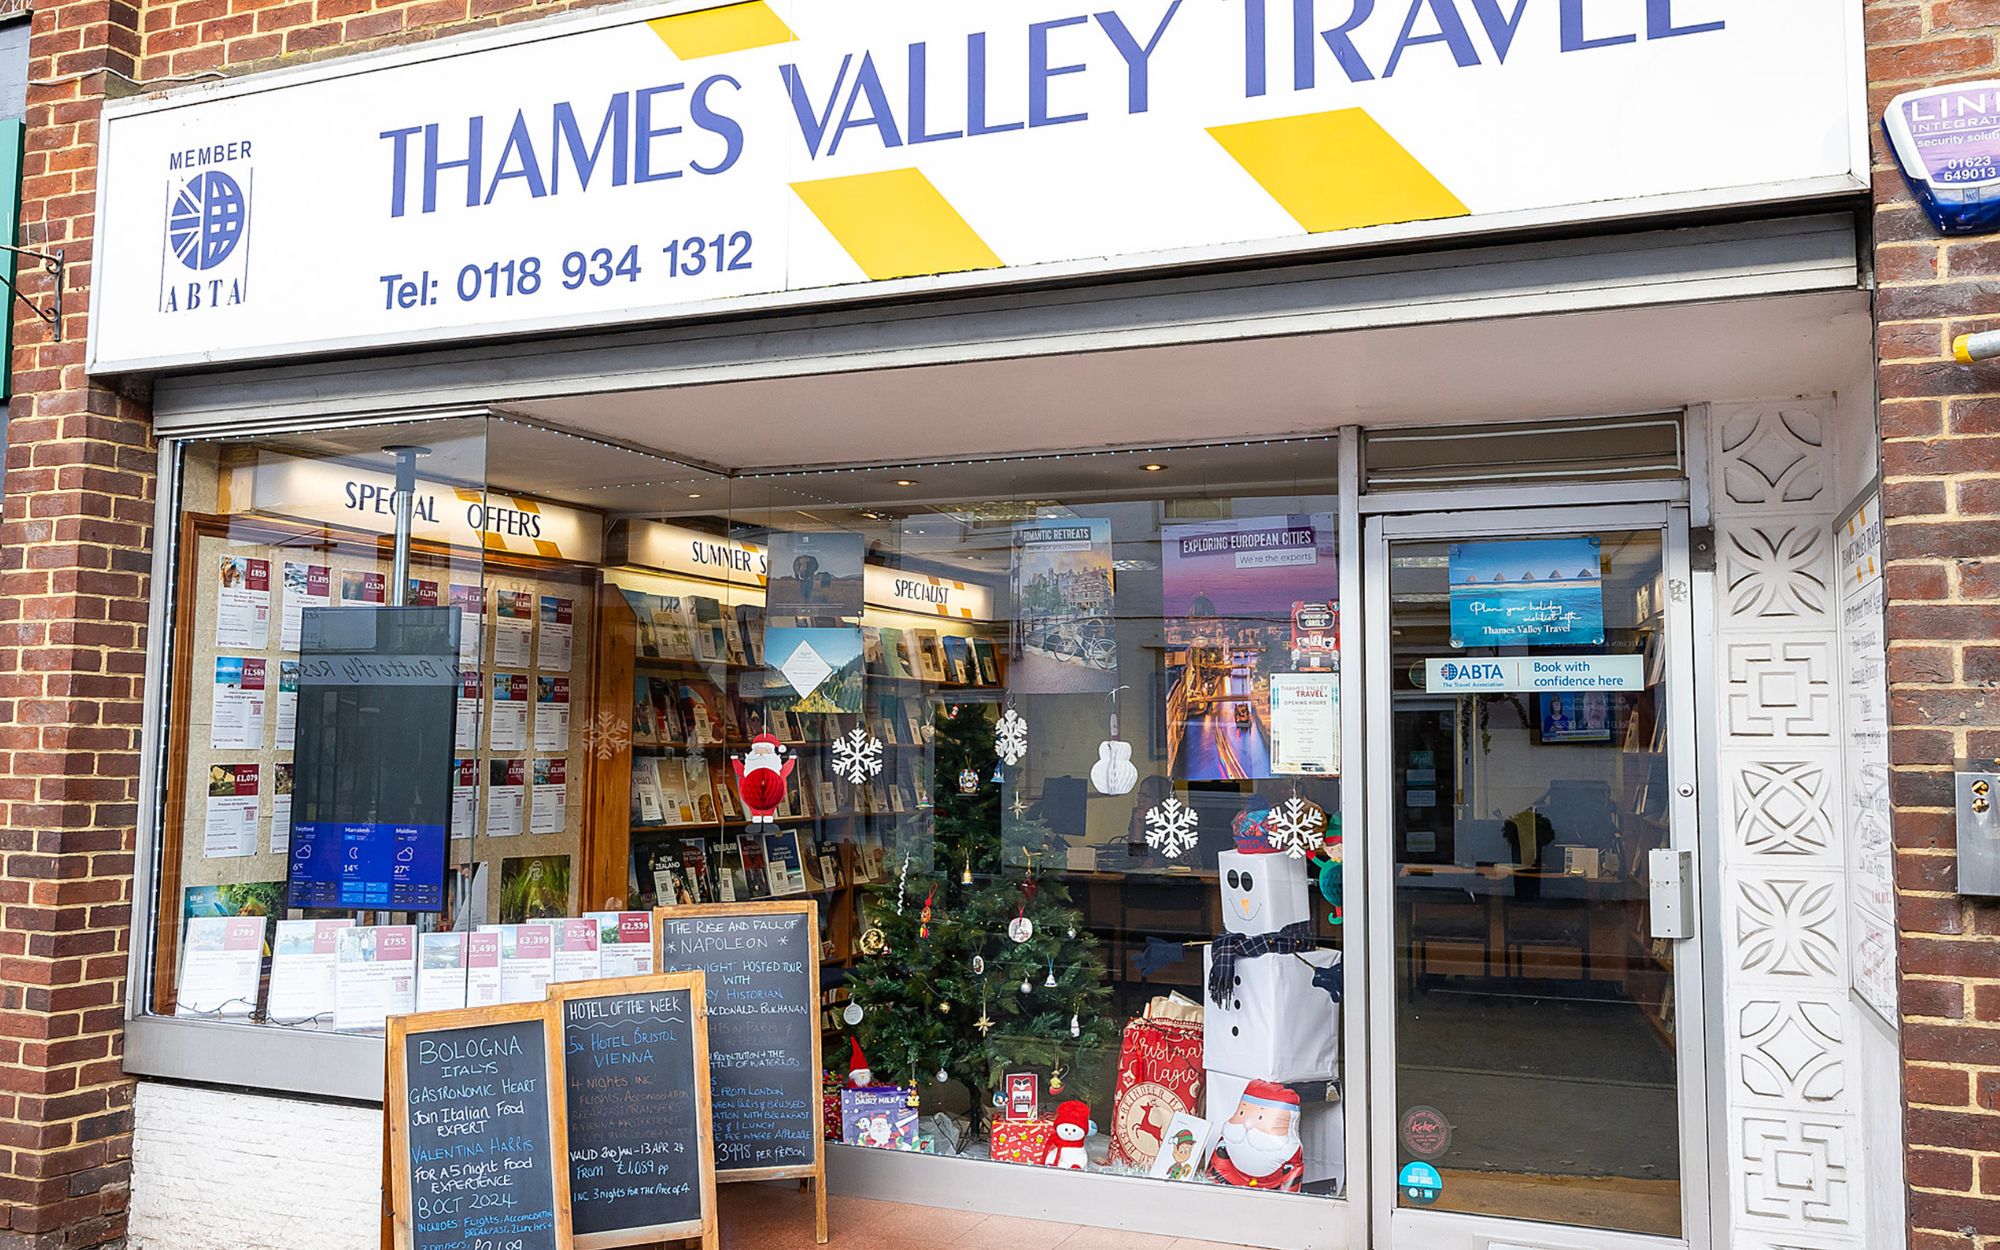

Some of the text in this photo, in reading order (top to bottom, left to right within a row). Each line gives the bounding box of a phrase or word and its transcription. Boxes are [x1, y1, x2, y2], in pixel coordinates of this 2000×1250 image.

[380, 73, 745, 219] THAMES
[779, 0, 1182, 160] VALLEY
[1911, 91, 2000, 122] LIN
[1917, 134, 1964, 148] security
[169, 141, 252, 170] MEMBER
[1947, 156, 1992, 170] 01623
[1943, 167, 1997, 182] 649013
[380, 230, 752, 311] Tel: 0118 934 1312
[164, 278, 243, 313] ABTA
[467, 503, 541, 538] OFFERS
[1053, 528, 1089, 540] RETREATS
[1183, 530, 1312, 553] EXPLORING EUROPEAN CITIES
[692, 541, 752, 573] SUMMER
[1240, 551, 1312, 564] We're the experts
[894, 578, 950, 605] SPECIALIST
[1482, 624, 1571, 636] Thames Valley Travel
[1458, 664, 1504, 679] ABTA
[1534, 661, 1591, 672] Book with
[1534, 675, 1624, 687] confidence here
[621, 922, 649, 930] £2,539
[667, 919, 799, 936] THE RISE AND FALL OF
[383, 937, 407, 947] £755
[680, 935, 769, 955] NAPOLEON
[742, 961, 781, 974] HOSTED
[782, 961, 803, 974] TOUR
[723, 975, 751, 986] WITH
[726, 987, 784, 1001] HISTORIAN
[570, 996, 682, 1020] HOTEL OF THE WEEK
[591, 1026, 678, 1052] HOTEL BRISTOL
[419, 1035, 523, 1065] BOLOGNA
[594, 1049, 655, 1069] VIENNA
[768, 1050, 785, 1059] THE
[735, 1060, 749, 1070] OF
[1143, 1055, 1196, 1091] Magic
[409, 1078, 537, 1105] GASTRONOMIC HEART
[721, 1083, 785, 1097] FROM LONDON
[855, 1096, 897, 1105] DAIRY MILK
[412, 1100, 525, 1127] Join Italian Food
[437, 1120, 488, 1138] EXPERT
[411, 1135, 535, 1164] VALENTINA HARRIS
[570, 1149, 598, 1162] VALID
[640, 1142, 652, 1155] 13
[414, 1166, 438, 1184] FOR
[504, 1156, 533, 1170] Food
[431, 1174, 514, 1194] EXPERIENCE
[574, 1192, 589, 1202] INC
[681, 1182, 691, 1194] 4
[432, 1196, 464, 1215] OCT
[469, 1193, 518, 1209] 2024
